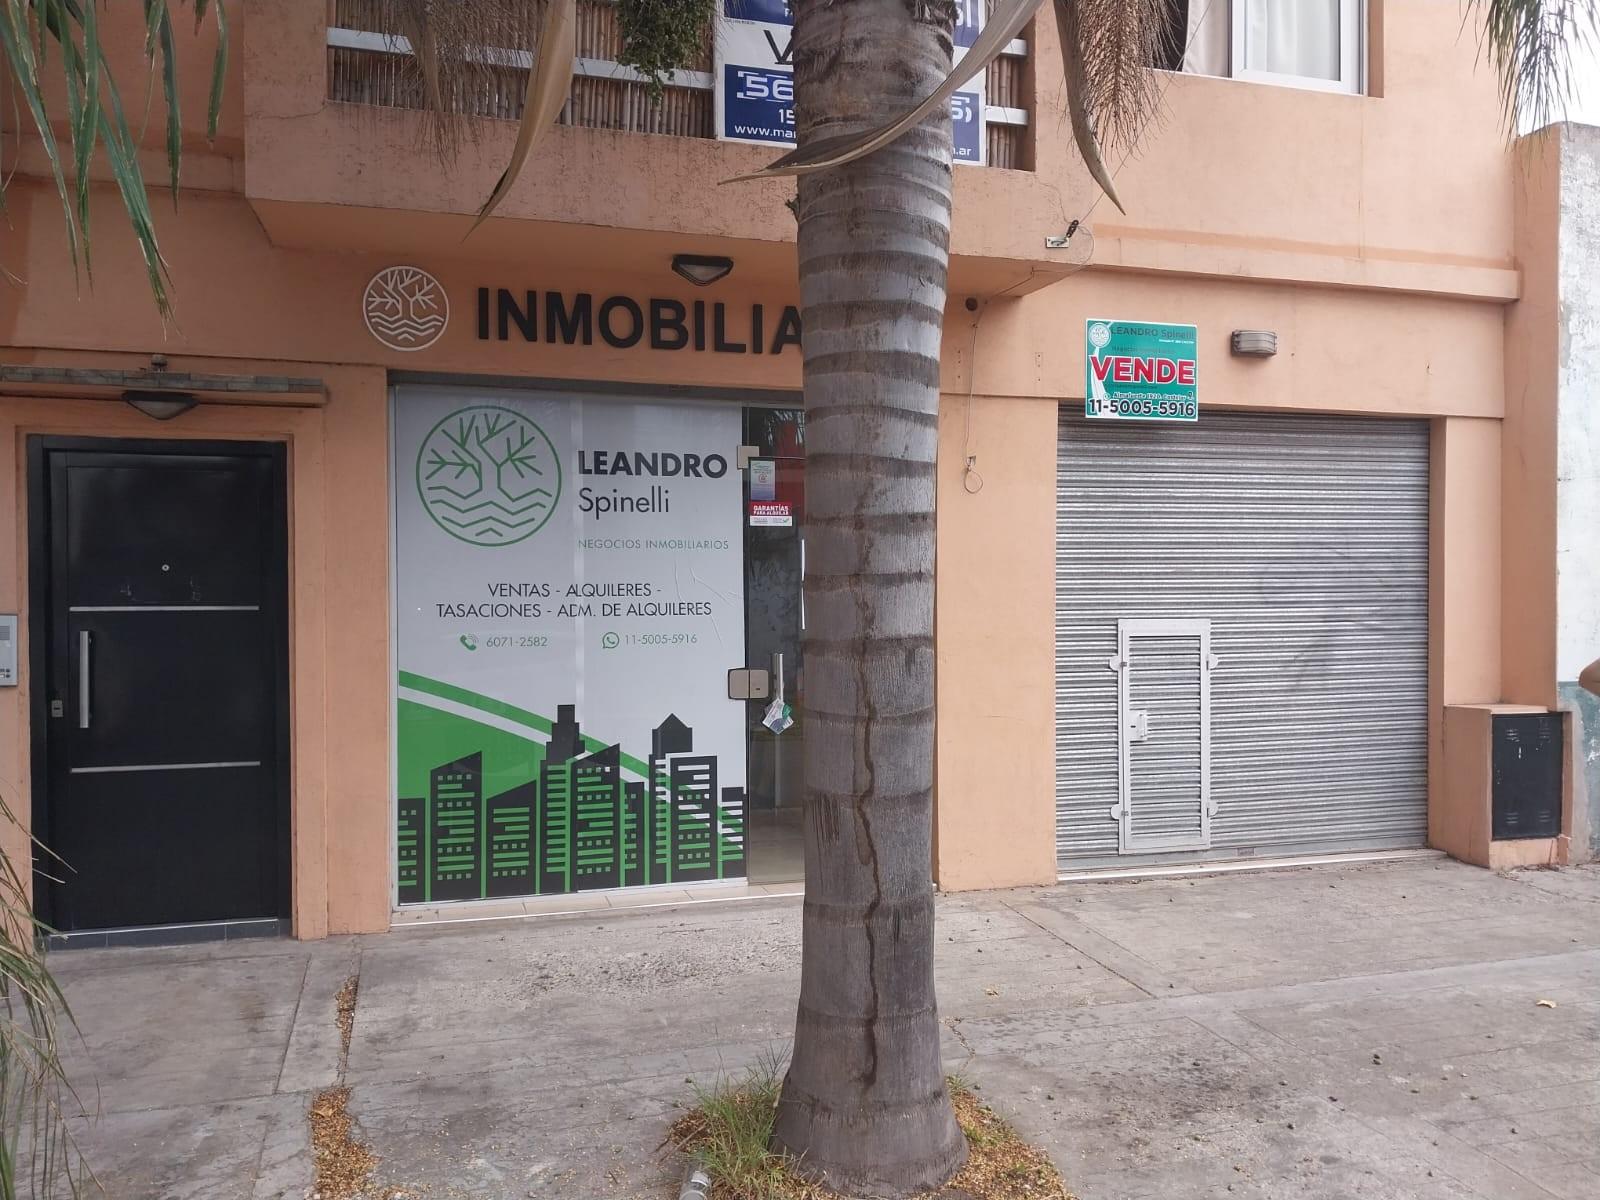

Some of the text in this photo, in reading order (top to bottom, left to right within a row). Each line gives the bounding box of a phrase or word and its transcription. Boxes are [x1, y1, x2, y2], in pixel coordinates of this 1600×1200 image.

[1111, 326, 1159, 337] LEANDRO
[1089, 355, 1195, 385] VENDE
[1089, 399, 1195, 416] 11-5005-5916
[577, 450, 728, 479] LEANDRO
[578, 487, 670, 520] Spinelli
[578, 538, 729, 551] NEGOCIOS INMOBILIARIOS
[487, 583, 551, 597] VENTAS
[565, 583, 652, 597] ALQUILERES
[436, 603, 542, 618] TASACIONES
[602, 603, 621, 617] DE
[626, 602, 712, 616] ALQUILERES
[486, 636, 548, 648] 6071-2582
[625, 634, 698, 645] 11-5005-5916
